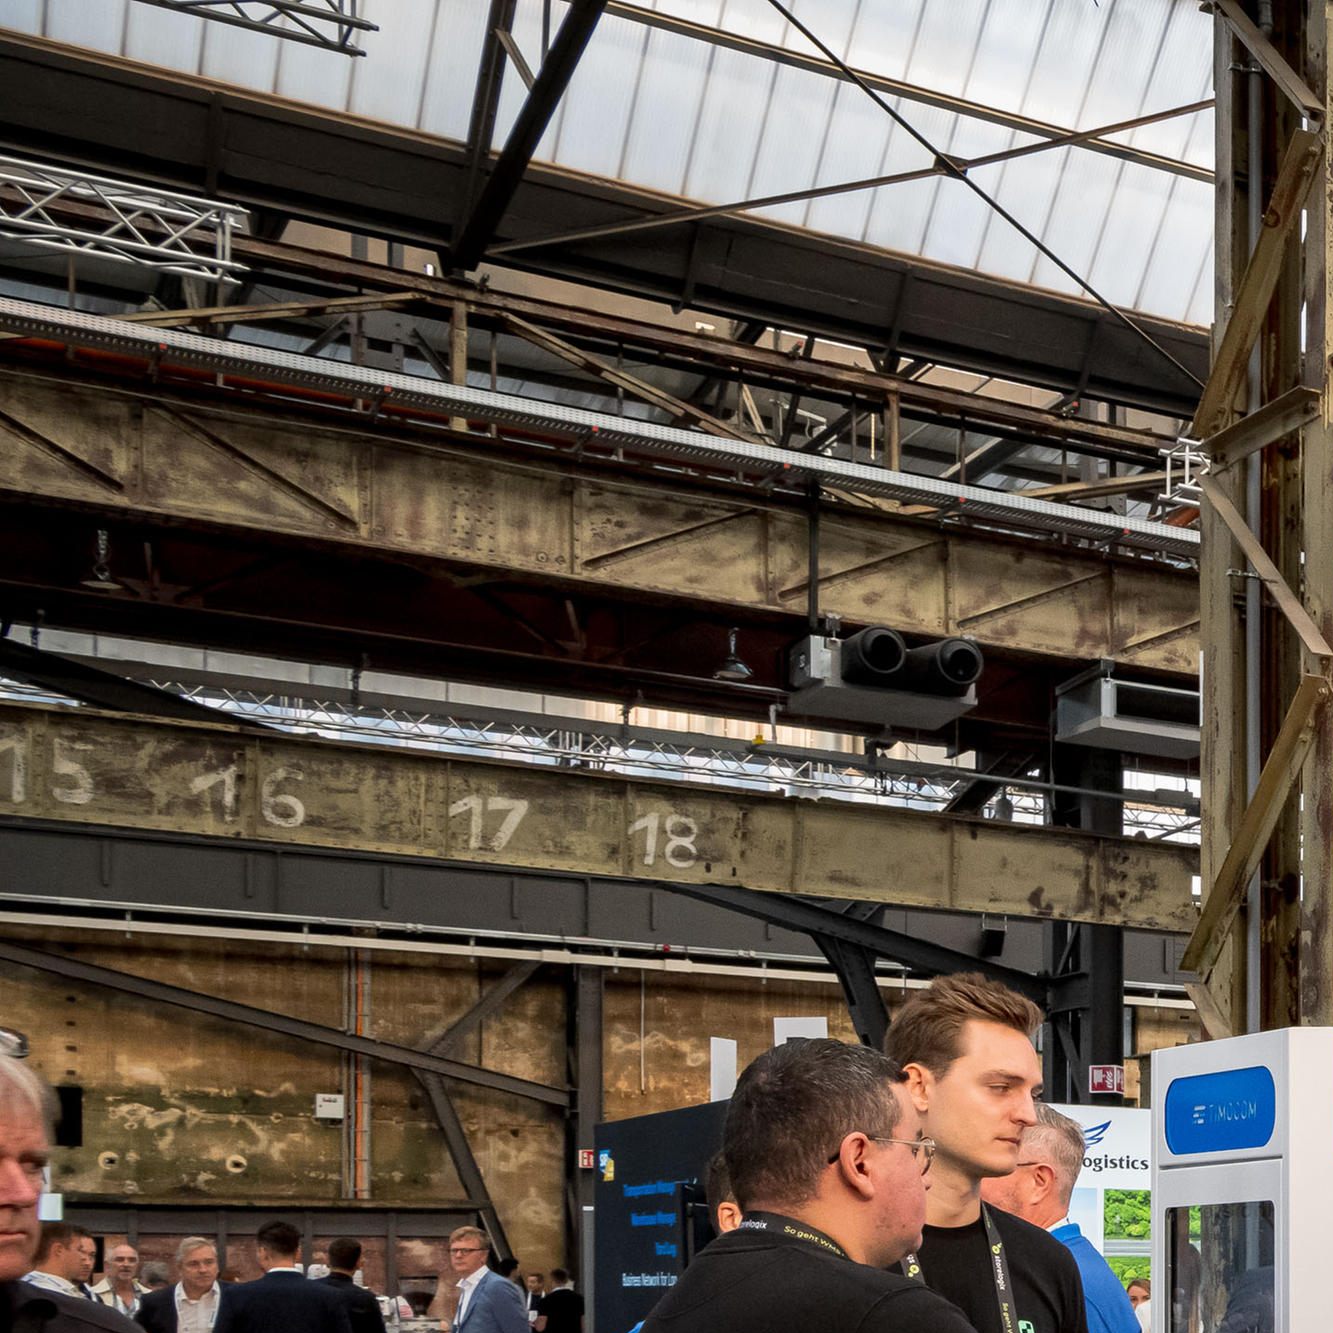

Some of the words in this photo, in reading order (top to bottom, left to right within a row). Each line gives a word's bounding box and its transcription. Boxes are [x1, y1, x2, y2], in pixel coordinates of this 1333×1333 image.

[189, 764, 305, 828] 16
[449, 794, 529, 851] 17
[628, 812, 699, 868] 18
[784, 1225, 796, 1235] So
[797, 1230, 819, 1243] geht
